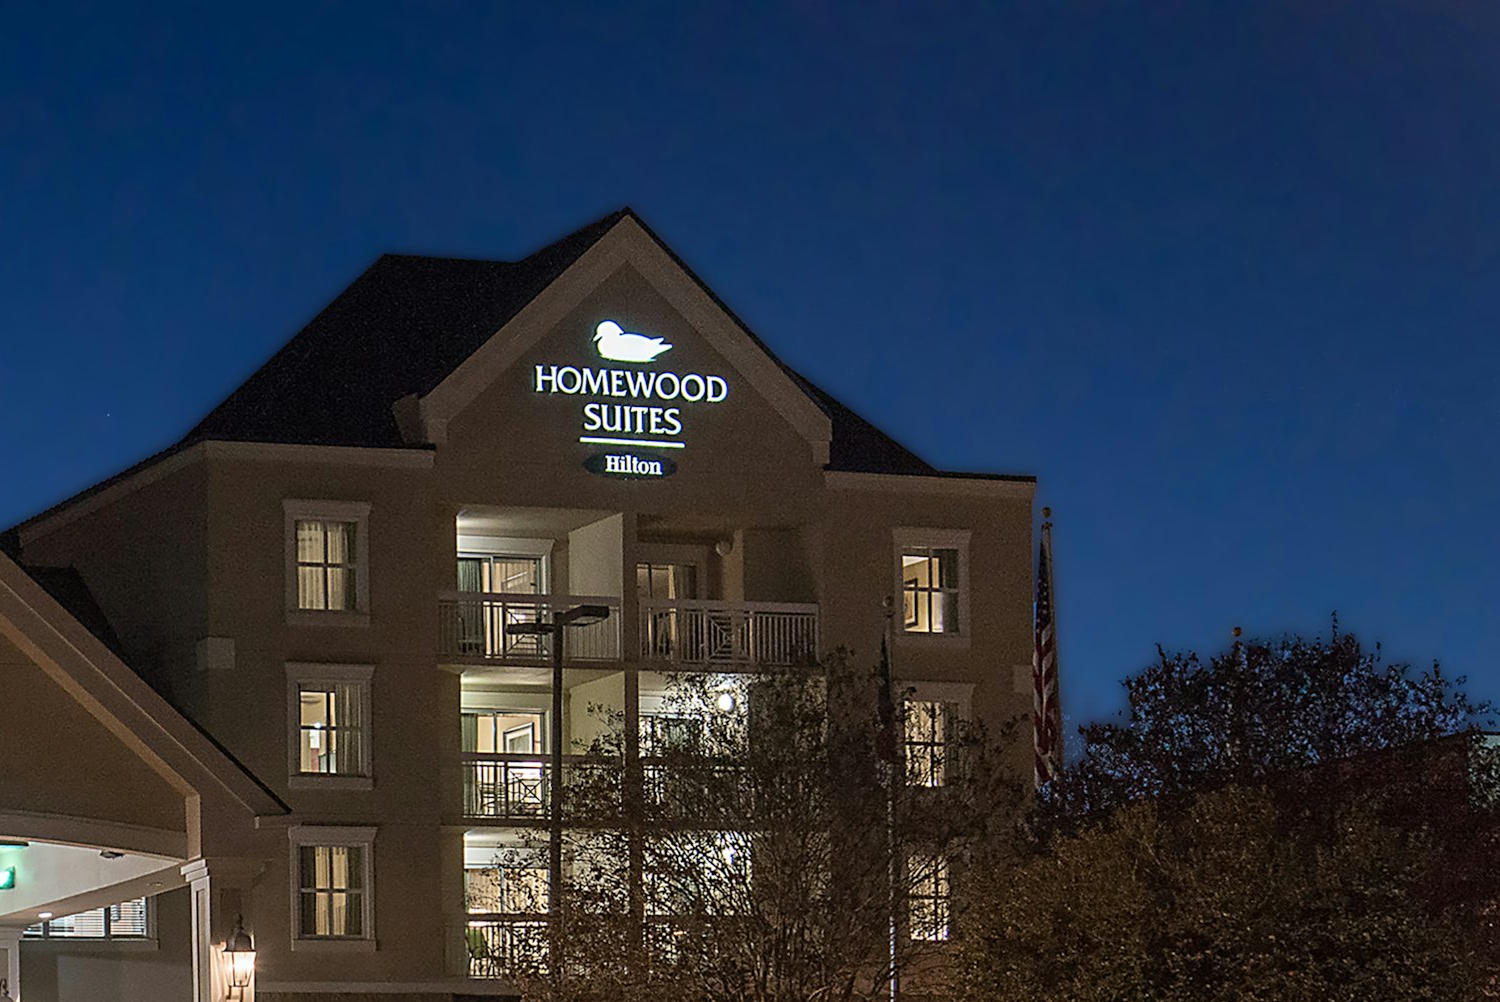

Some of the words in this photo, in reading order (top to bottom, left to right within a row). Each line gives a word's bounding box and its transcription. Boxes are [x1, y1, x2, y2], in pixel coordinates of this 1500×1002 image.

[534, 364, 728, 403] HOMEWOOD
[583, 403, 683, 435] SUITES
[605, 455, 663, 475] Hilton
